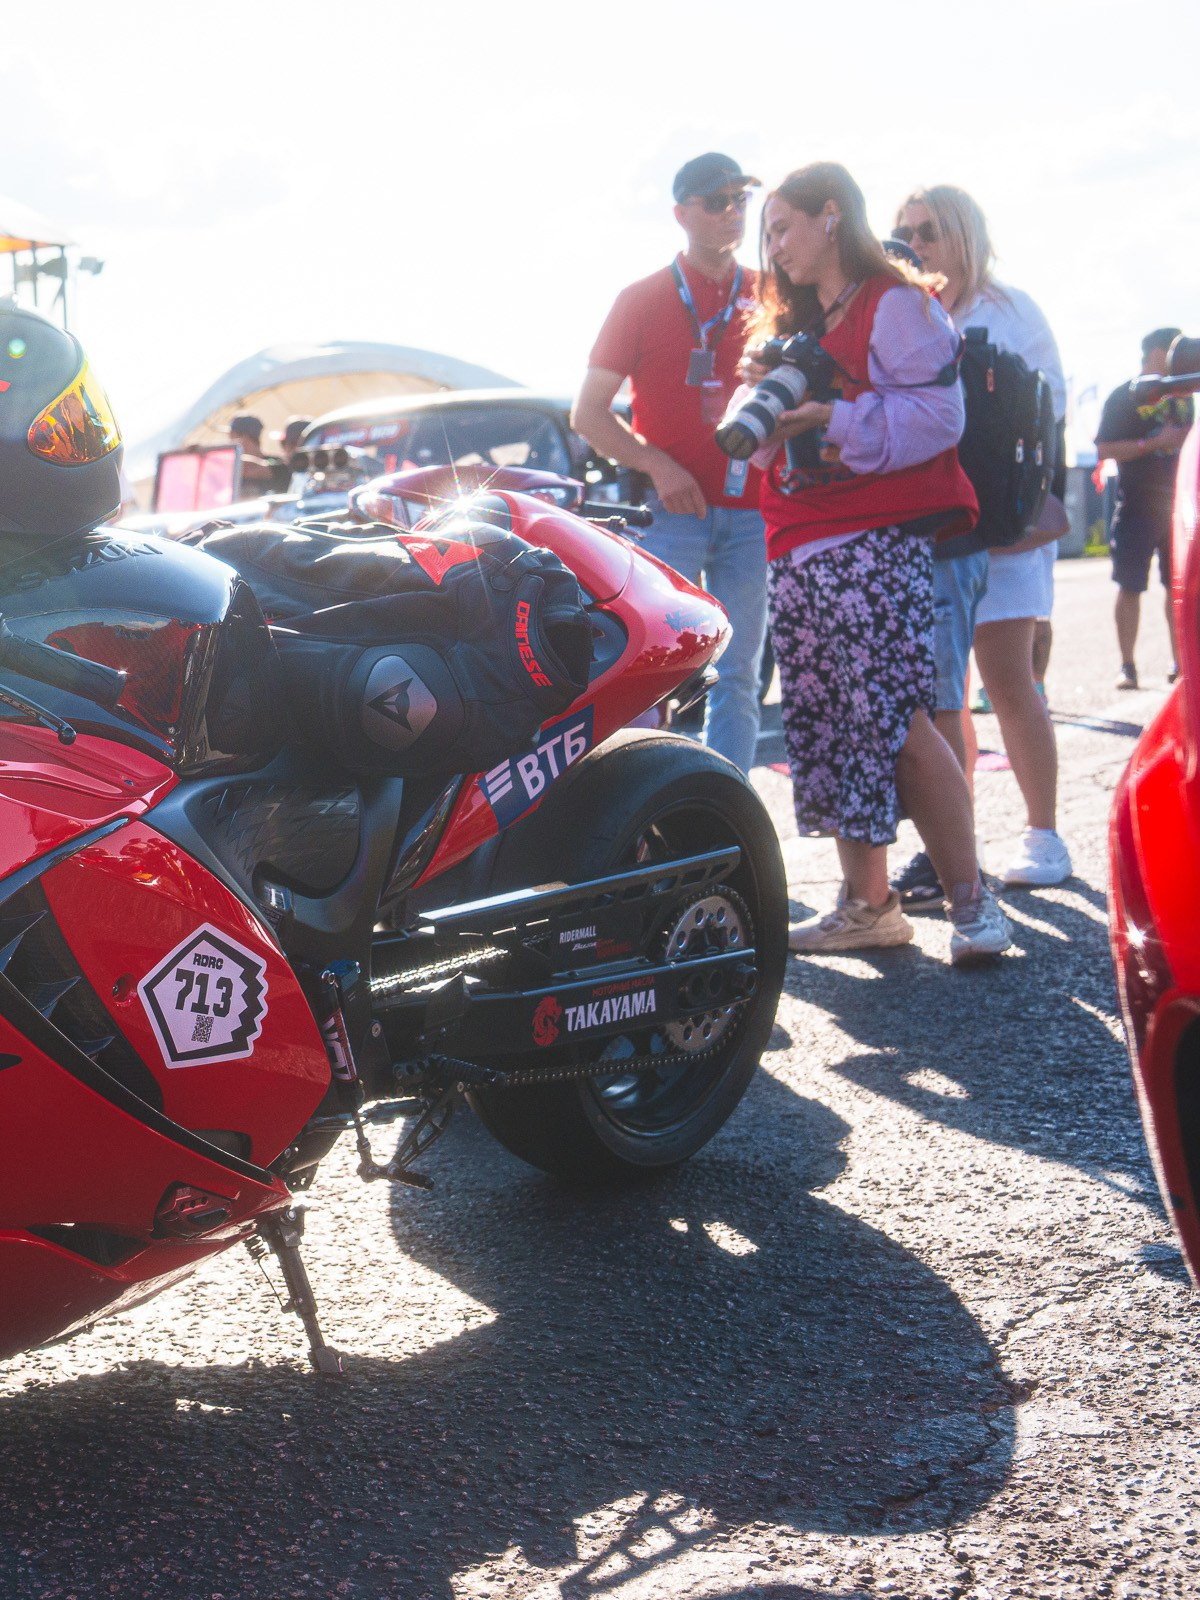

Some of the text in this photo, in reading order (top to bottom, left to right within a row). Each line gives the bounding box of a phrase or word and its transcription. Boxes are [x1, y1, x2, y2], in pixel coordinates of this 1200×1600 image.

[14, 541, 164, 591] SZUKI
[515, 600, 553, 687] DAINESE
[516, 721, 587, 801] ВТБ
[559, 925, 597, 944] RIDERMALL
[193, 953, 224, 970] RDRC
[175, 968, 234, 1018] 713
[565, 988, 657, 1032] TAKAYAMA
